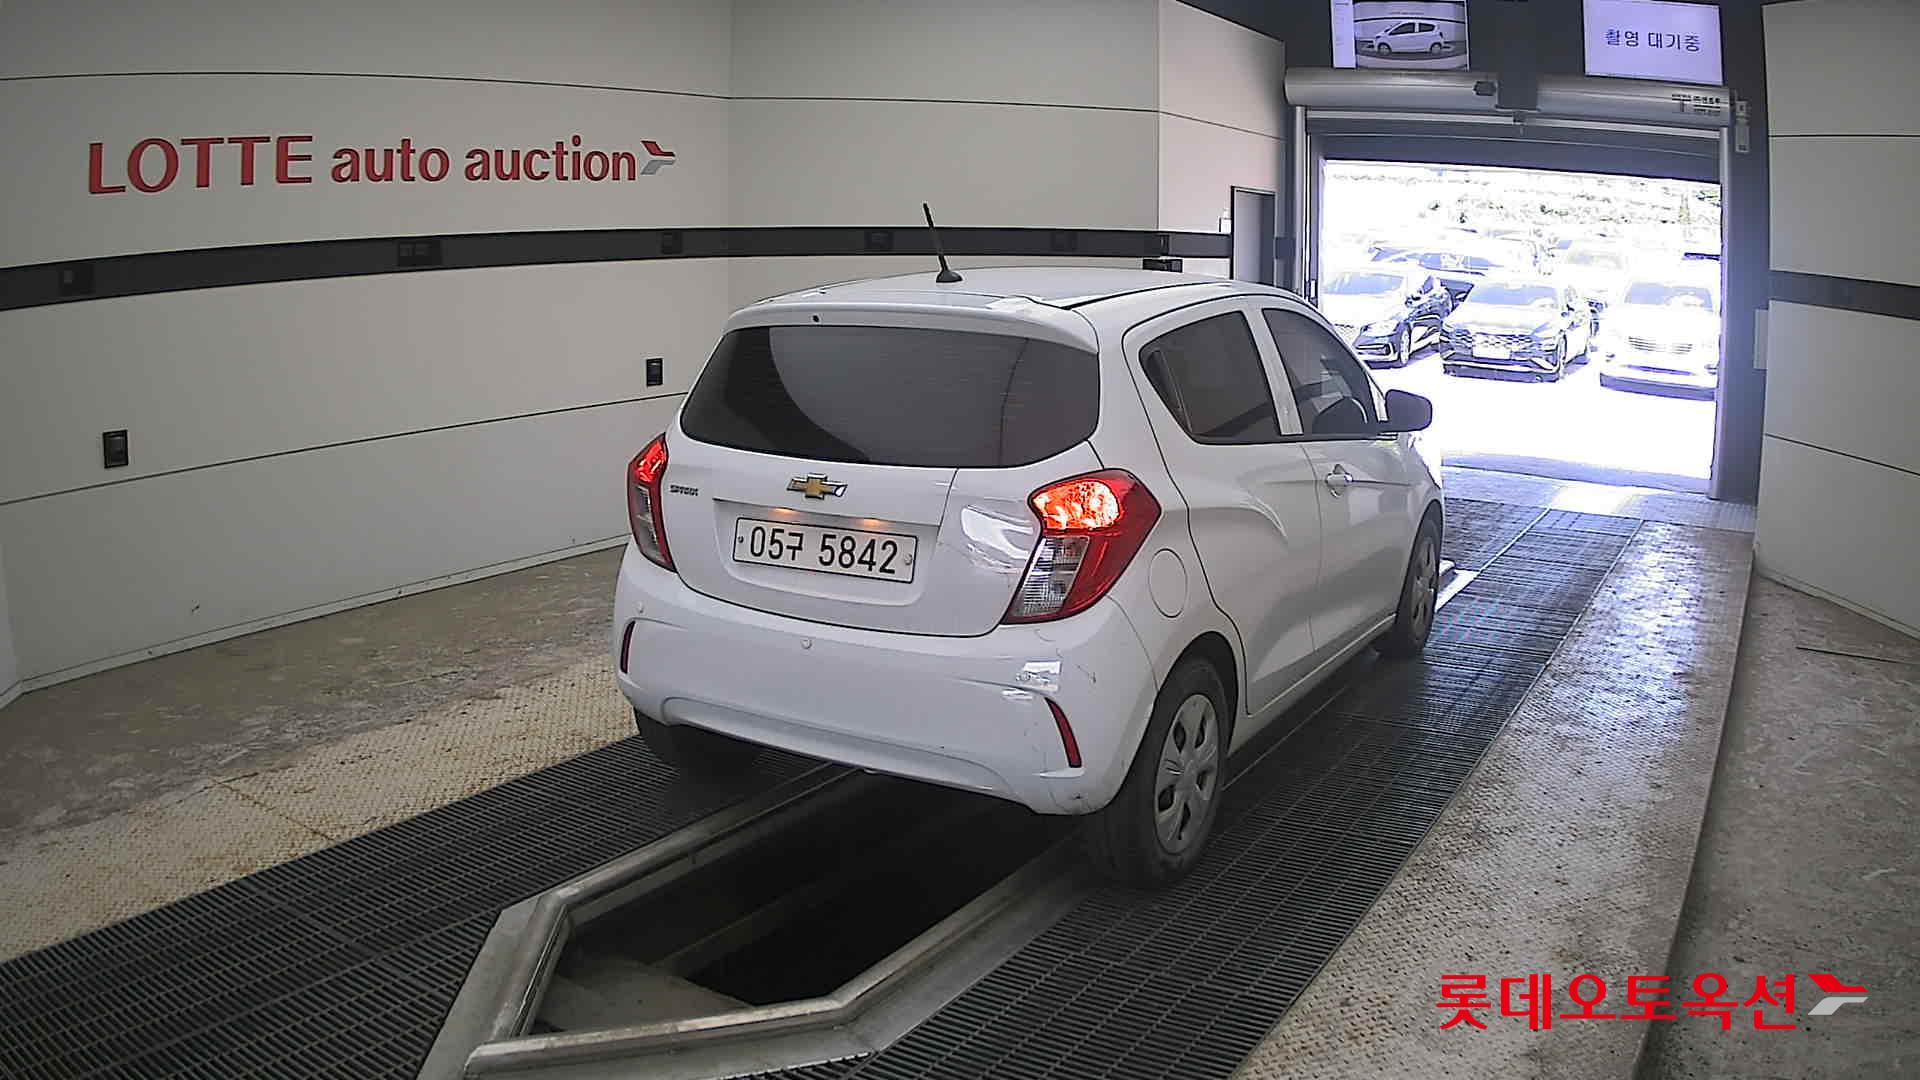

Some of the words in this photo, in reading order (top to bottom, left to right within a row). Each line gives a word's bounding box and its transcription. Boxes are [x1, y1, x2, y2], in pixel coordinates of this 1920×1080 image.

[1647, 31, 1701, 52] 대기중
[88, 135, 313, 195] LOTTE
[330, 138, 451, 183] auto
[464, 134, 638, 183] auction
[750, 526, 804, 561] 05구
[818, 533, 899, 575] 5842
